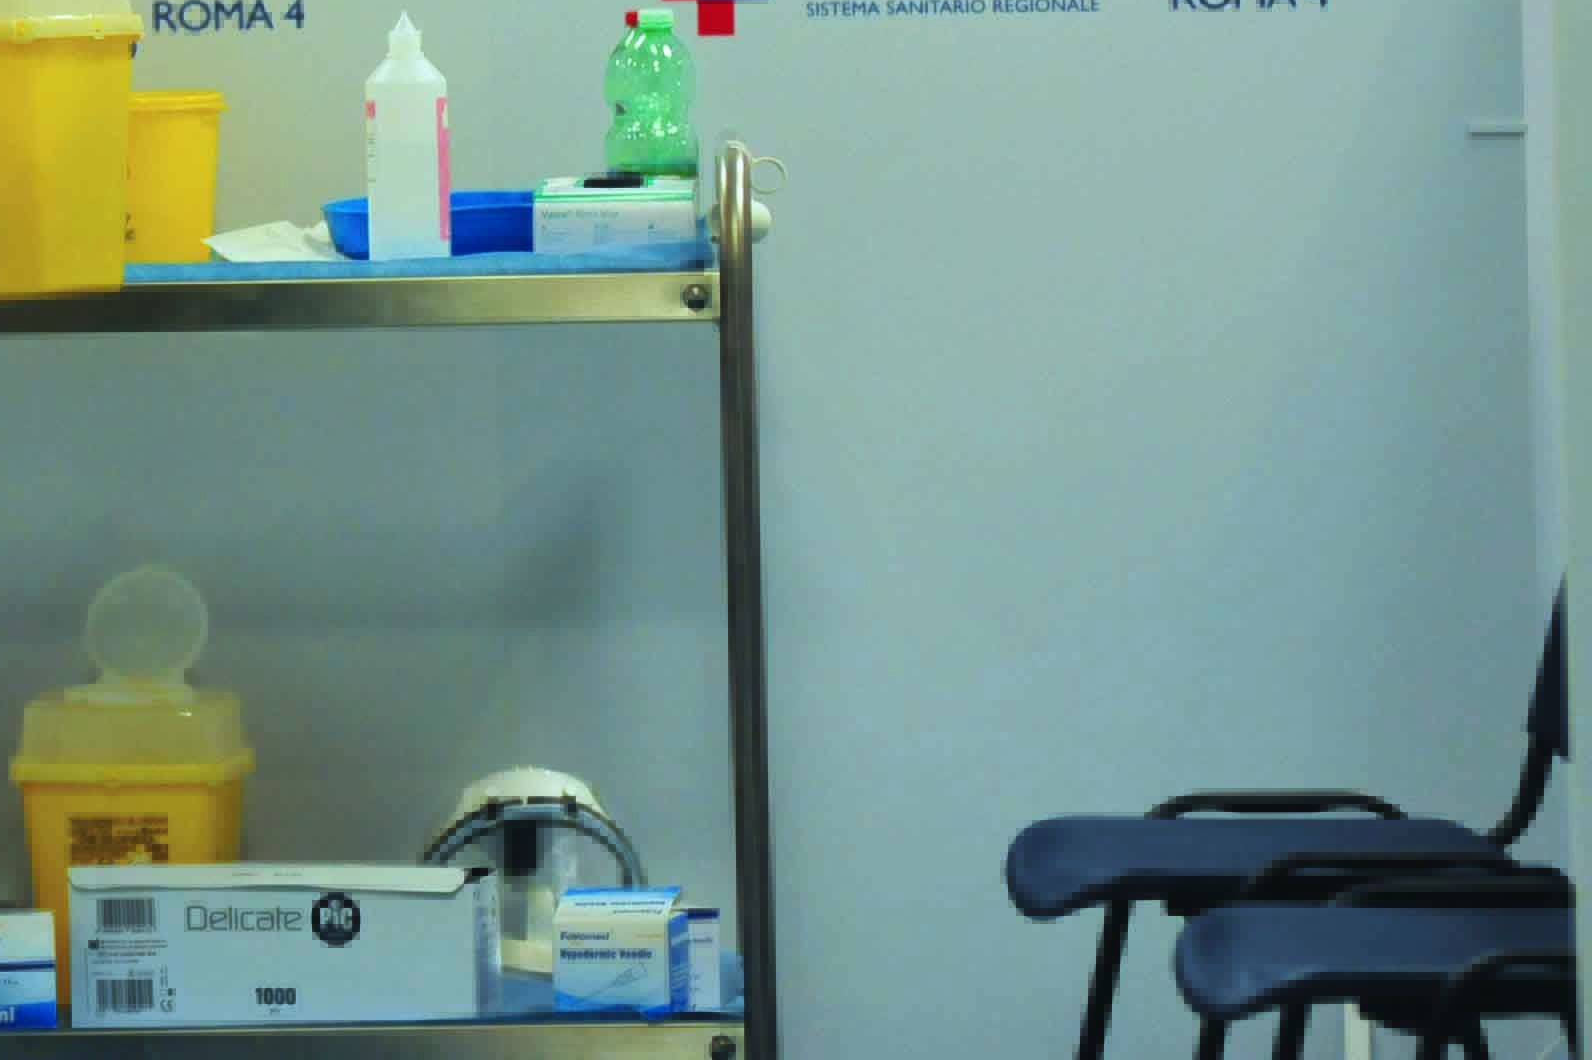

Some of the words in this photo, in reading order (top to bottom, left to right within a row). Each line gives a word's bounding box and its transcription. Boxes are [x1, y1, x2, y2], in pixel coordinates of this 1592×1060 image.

[806, 1, 881, 18] SISTEMA
[186, 904, 303, 932] Delicate
[255, 987, 296, 1005] 1000
